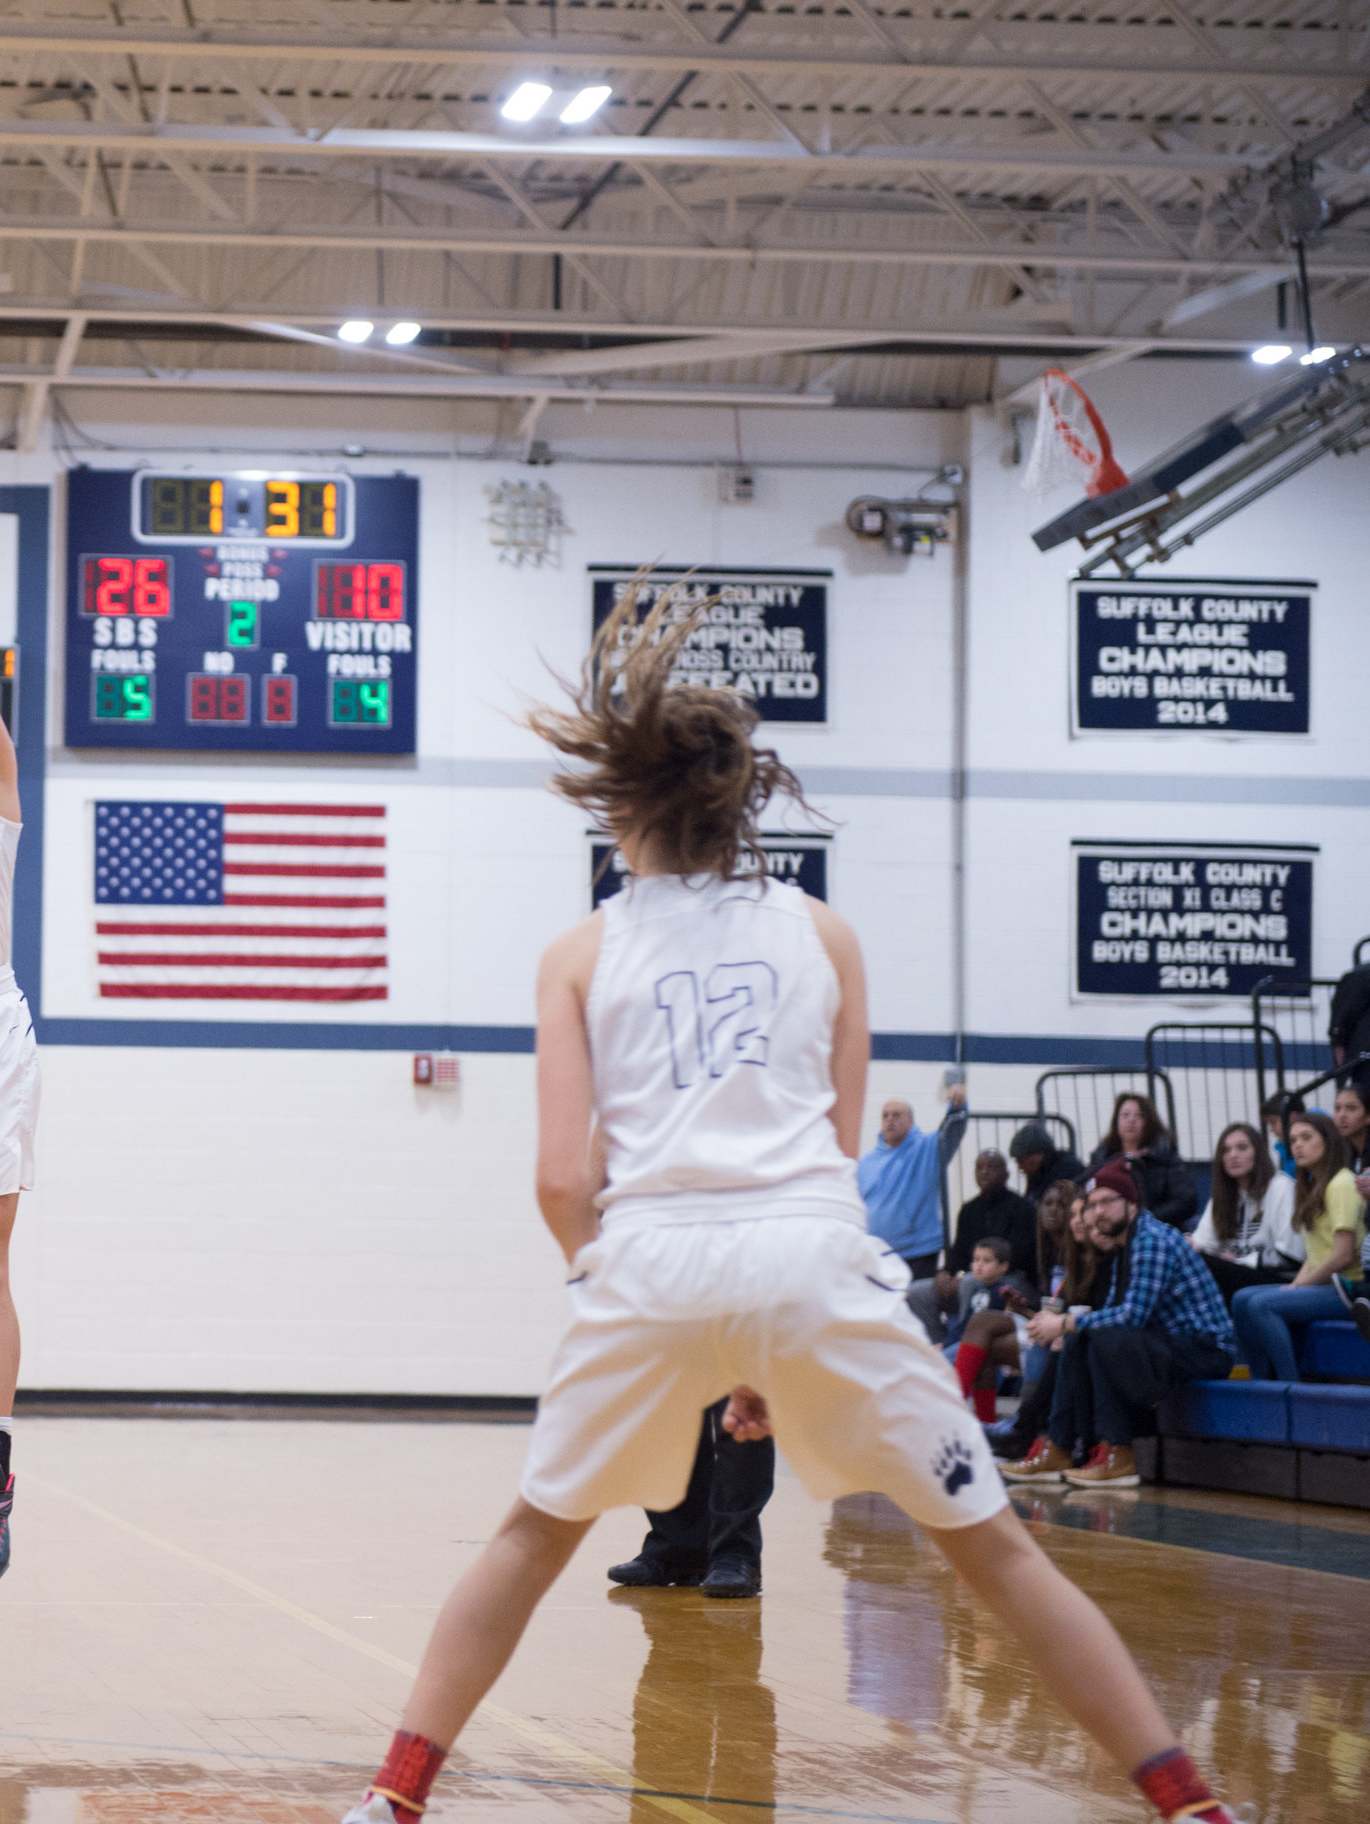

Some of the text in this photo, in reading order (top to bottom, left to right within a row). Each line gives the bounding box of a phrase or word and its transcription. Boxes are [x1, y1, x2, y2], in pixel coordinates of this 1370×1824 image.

[97, 557, 171, 616] 26
[204, 577, 280, 602] PERIOD
[351, 563, 404, 621] 10
[719, 585, 804, 607] COUNTY
[229, 601, 256, 647] 2
[1097, 597, 1290, 624] SUFFOLK COUNTY
[305, 622, 412, 652] VISITOR
[1137, 622, 1249, 647] LEAGUE
[91, 650, 156, 671] FOULS
[271, 652, 288, 673] F
[327, 655, 392, 676] FOULS
[729, 651, 817, 672] COUNTRY
[1099, 647, 1287, 677] CHAMPIONS
[123, 675, 152, 721] 5
[359, 680, 388, 724] 4
[1091, 675, 1295, 702] BOYS BASKETBALL
[1157, 701, 1229, 725] 2014
[1098, 861, 1291, 888] SUFFOLK COUNTY
[1107, 886, 1283, 911] SECTION XI CLASS C
[1100, 911, 1288, 940] CHAMPIONS
[1092, 940, 1296, 967] BOYS BASKETBALL
[1159, 966, 1230, 989] 2014
[654, 960, 779, 1090] 12
